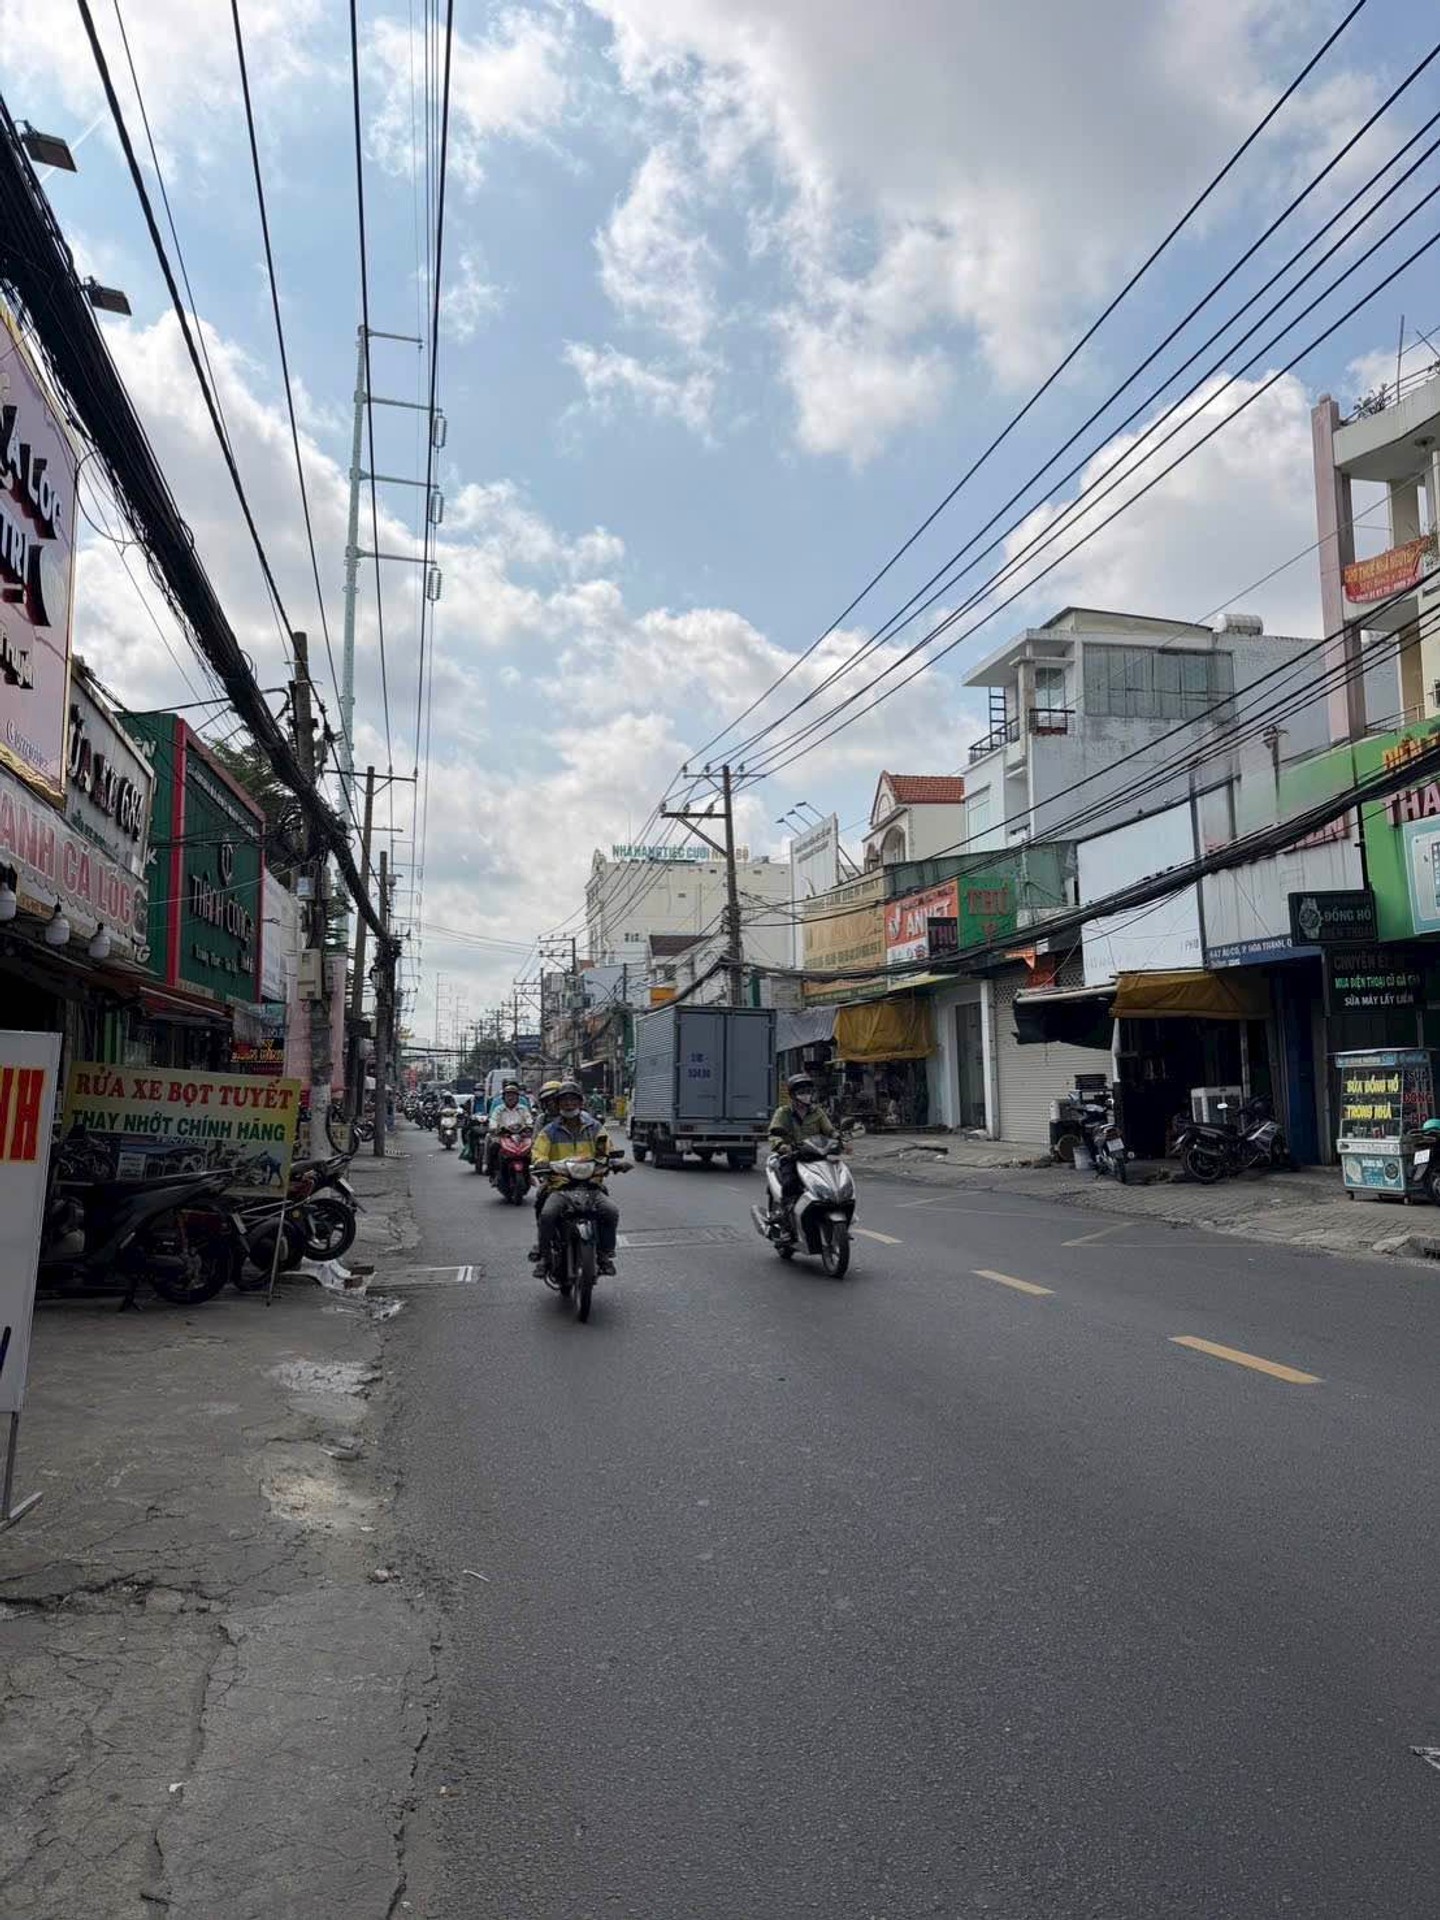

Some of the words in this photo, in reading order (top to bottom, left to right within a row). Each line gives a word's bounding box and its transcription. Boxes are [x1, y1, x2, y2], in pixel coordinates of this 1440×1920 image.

[75, 1066, 125, 1098] RỬA
[132, 1079, 163, 1102] XE
[167, 1081, 213, 1108] BỌT
[219, 1079, 294, 1110] TUYẾT
[72, 1109, 119, 1130] THAY
[124, 1111, 173, 1135] NHỚT
[177, 1117, 231, 1139] CHÍNH
[237, 1118, 286, 1142] HÃNG
